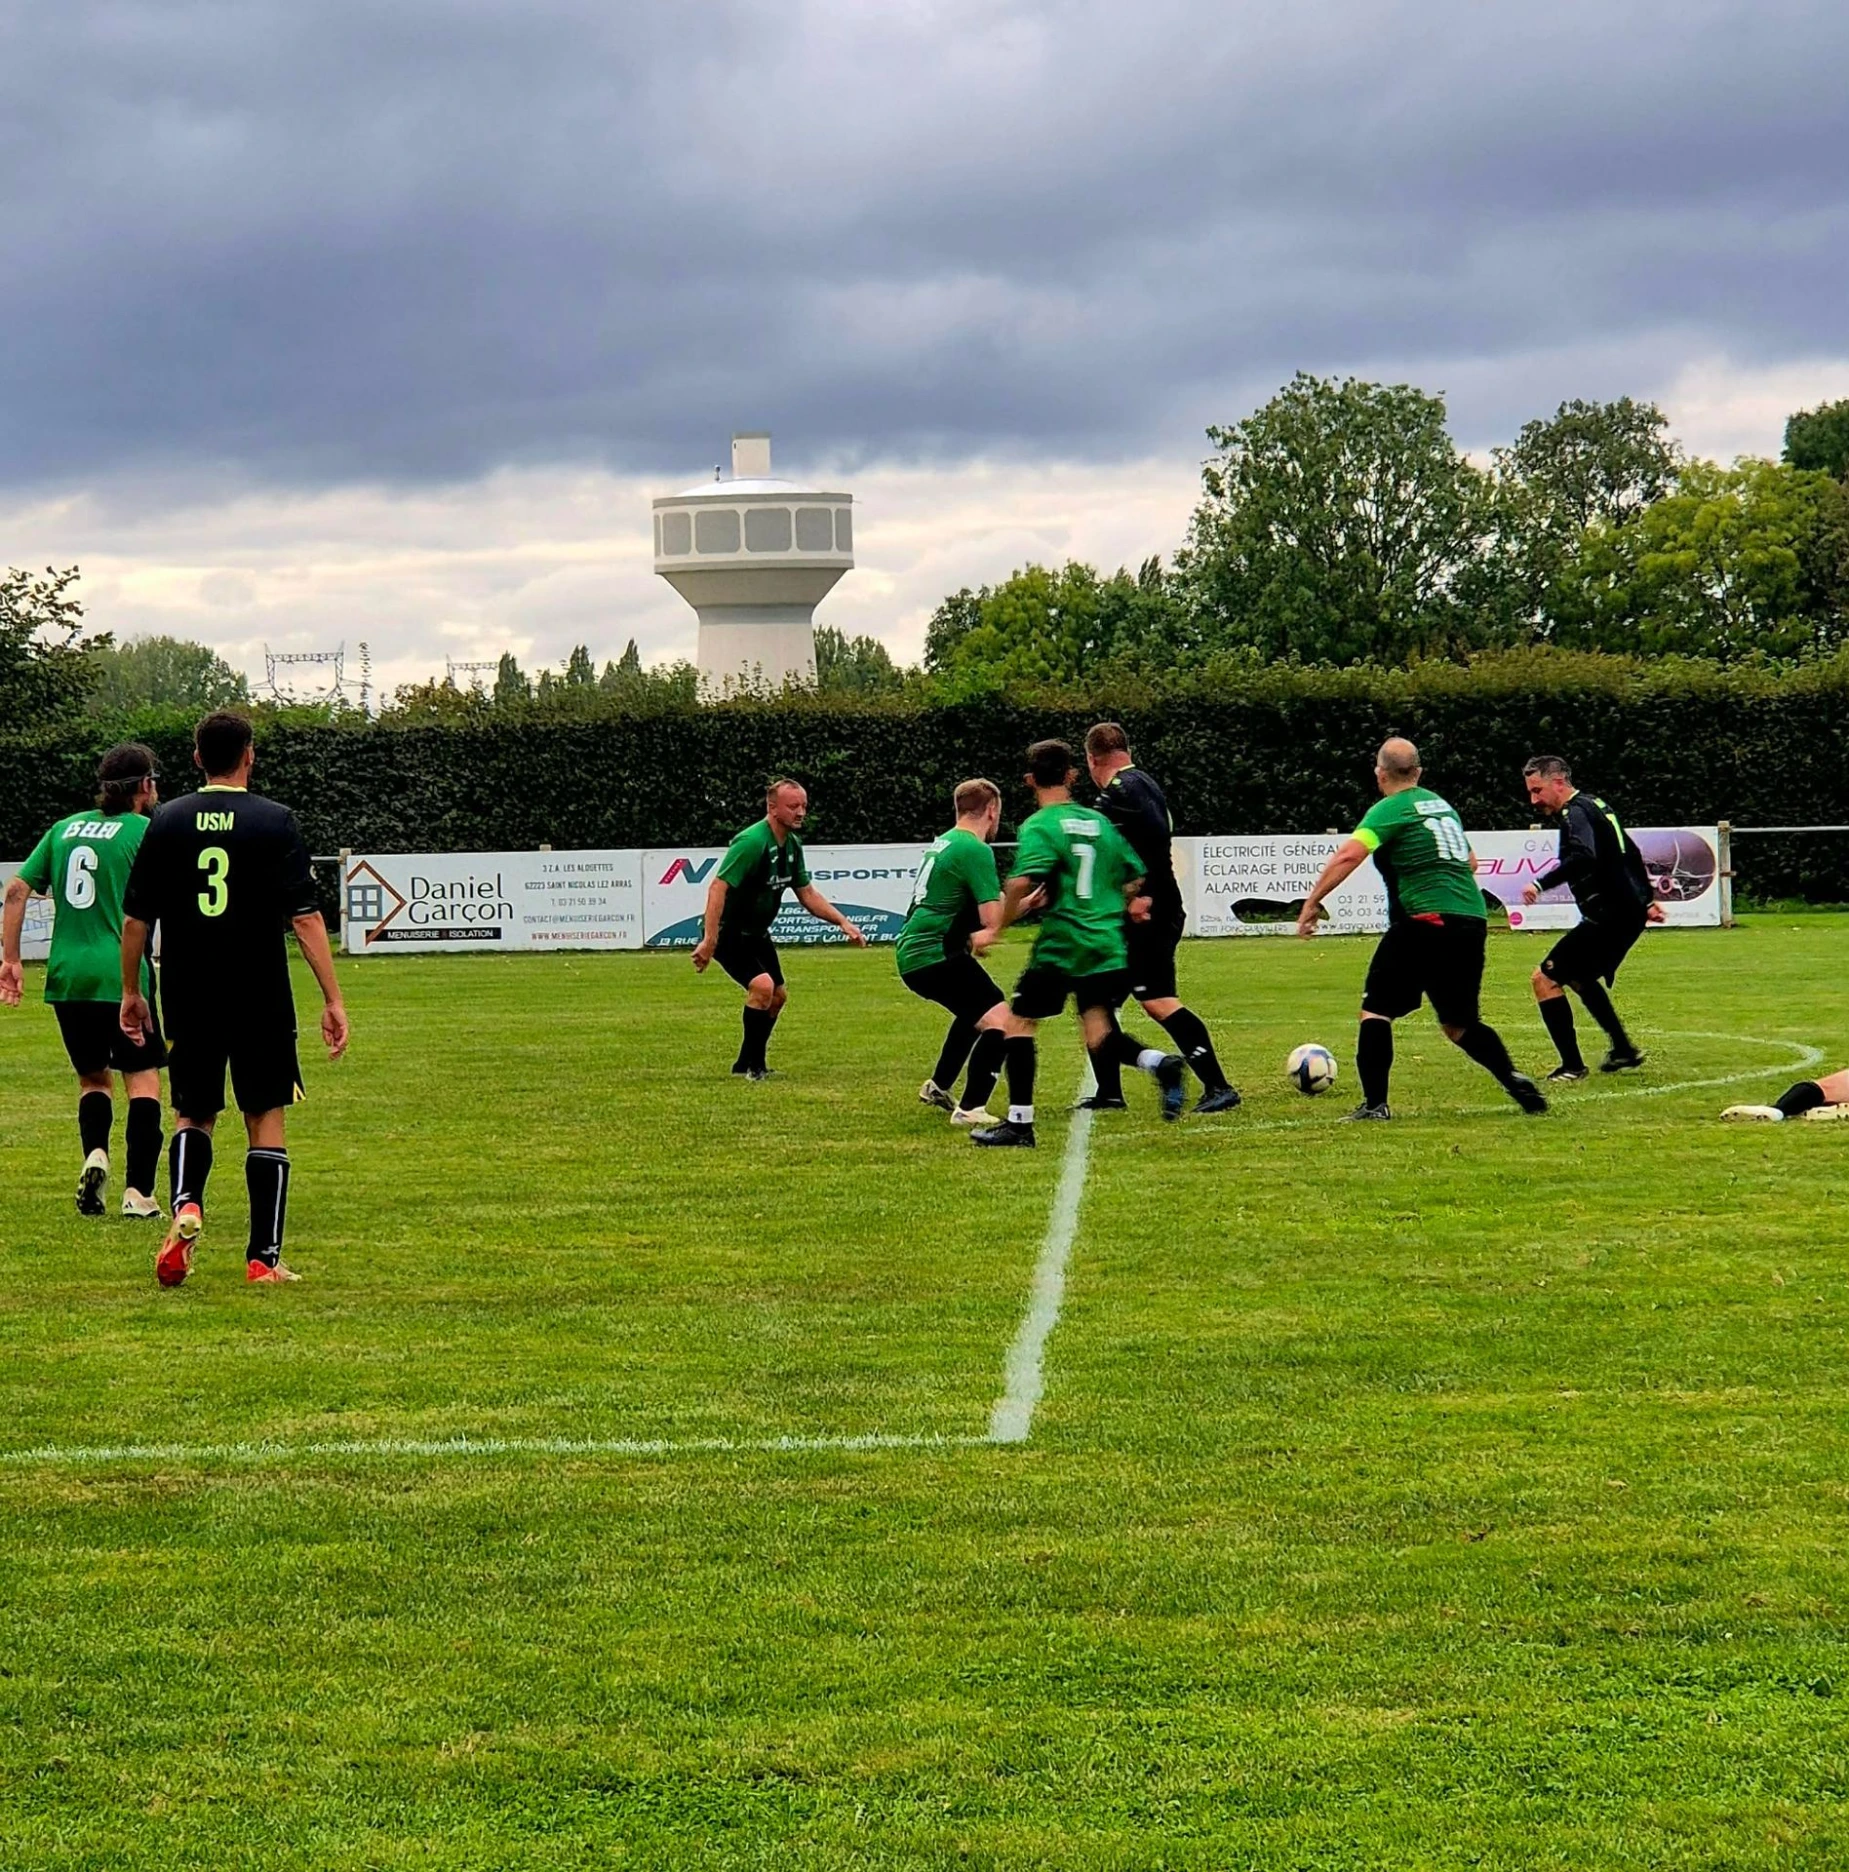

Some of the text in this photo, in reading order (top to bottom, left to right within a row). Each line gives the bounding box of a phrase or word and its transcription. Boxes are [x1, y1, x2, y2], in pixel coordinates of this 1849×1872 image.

[196, 811, 235, 831] USM
[1422, 816, 1469, 862] 10
[1203, 841, 1339, 858] ÉLECTRICITÉ GÉNÉRA
[563, 864, 575, 872] LES
[577, 863, 614, 872] ALOUETTES
[1071, 843, 1097, 900] 7
[1203, 861, 1278, 876] ÉCLAIRAGE
[65, 846, 98, 909] 6
[197, 846, 230, 917] 3
[524, 881, 545, 890] 62223
[546, 881, 566, 889] SAINT
[567, 880, 596, 889] NICOLAS
[610, 879, 632, 888] ARRAS
[411, 872, 505, 900] Daniel
[1204, 881, 1259, 894] ALARME
[1337, 895, 1353, 904] 03
[1358, 894, 1368, 904] 21
[408, 900, 514, 925] Garçon
[1337, 908, 1353, 917] 06
[1357, 908, 1372, 917] 03
[387, 930, 440, 940] MENUISERIE
[448, 929, 494, 939] ISOLATION
[674, 937, 699, 946] RUE
[803, 934, 820, 943] ST
